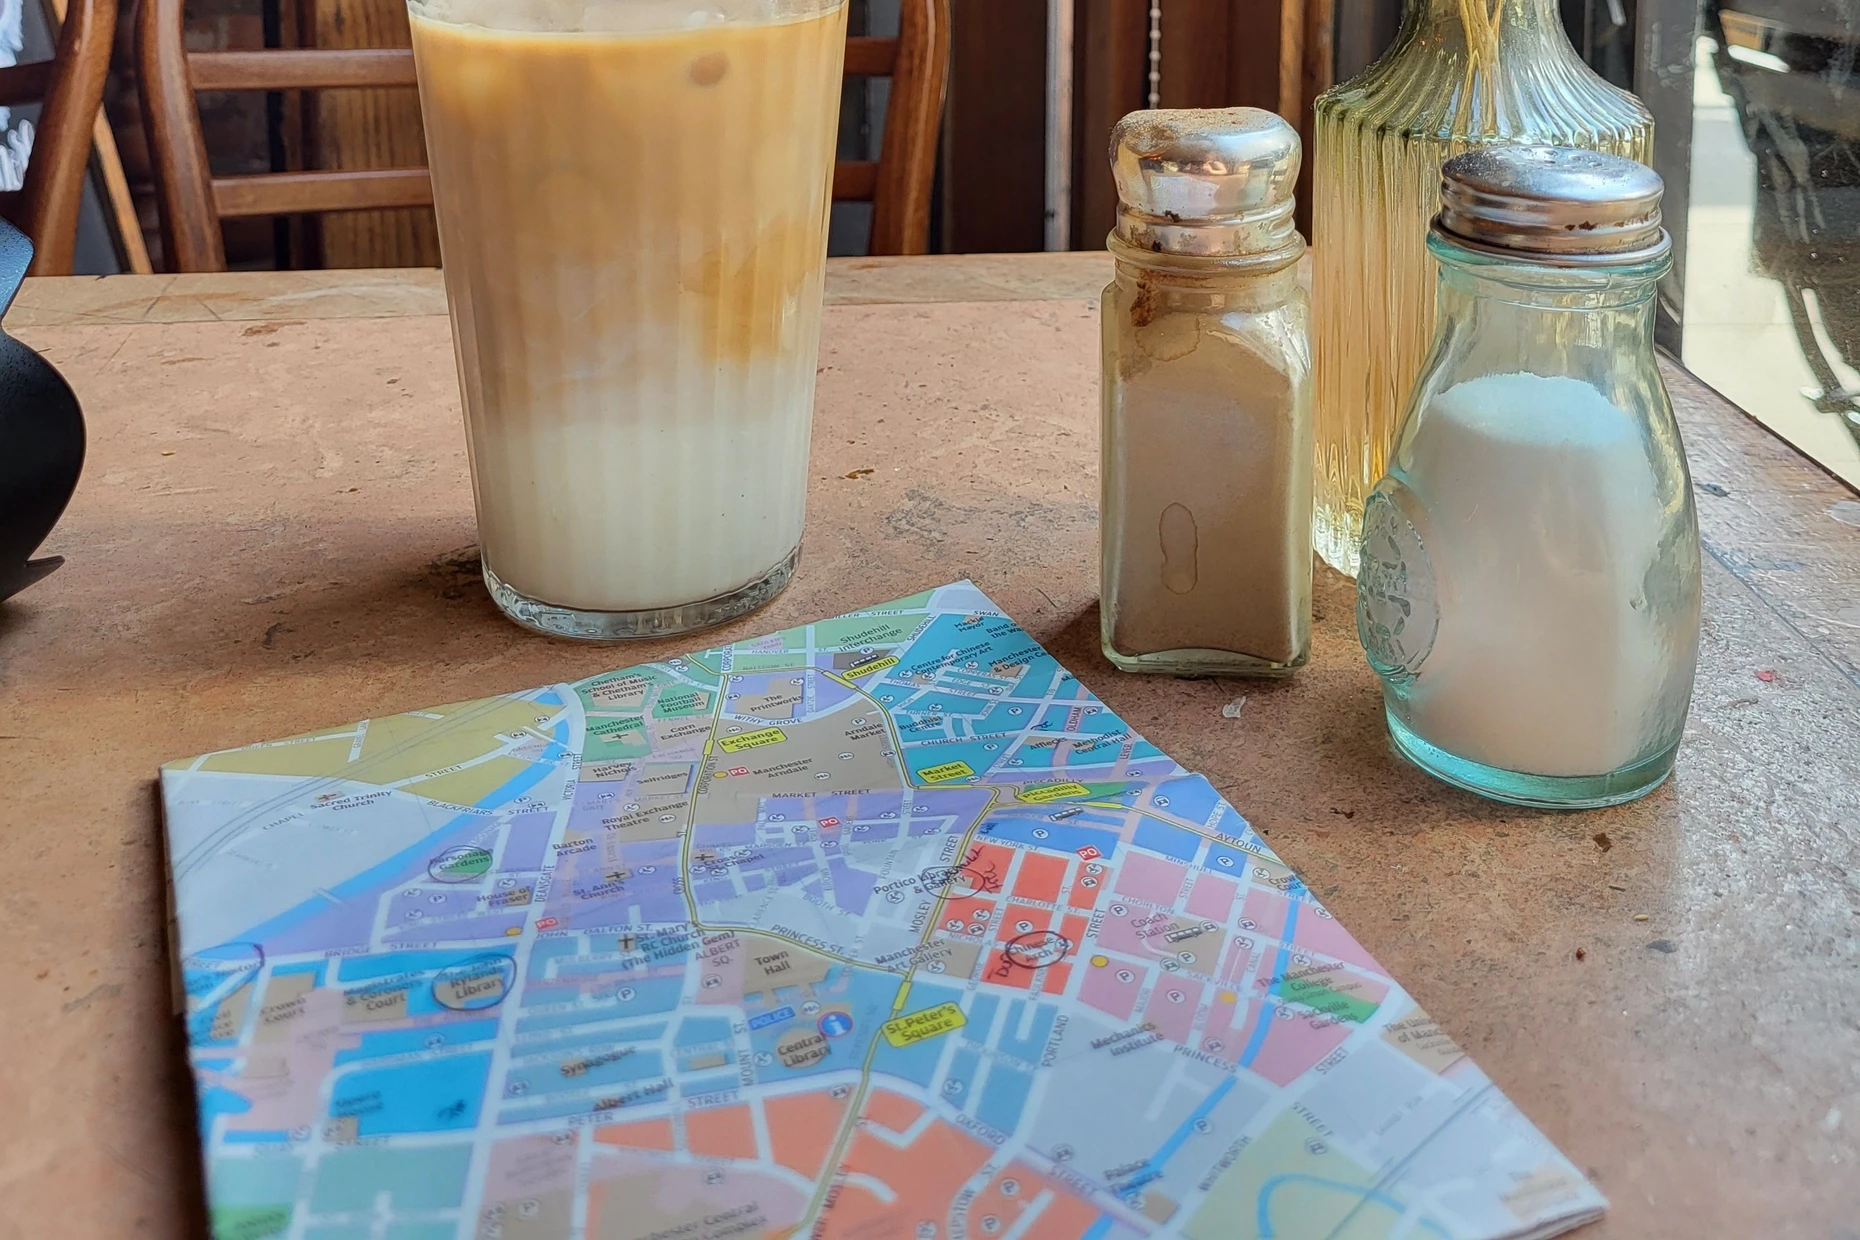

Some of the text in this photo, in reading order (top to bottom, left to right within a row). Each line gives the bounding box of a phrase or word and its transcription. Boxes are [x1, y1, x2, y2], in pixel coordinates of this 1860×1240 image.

[840, 624, 889, 643] Shudehill
[907, 615, 936, 642] SHUDEHILL
[839, 627, 903, 652] Interchange
[911, 641, 991, 671] Centre Chinese
[915, 651, 978, 675] Contemporary
[988, 646, 1041, 667] Manchester
[1003, 654, 1035, 671] Design
[846, 658, 896, 679] Shudehill
[581, 675, 657, 694] School Music
[591, 673, 641, 687] Chetham's
[602, 682, 654, 696] Chetham's
[608, 689, 644, 701] Library
[657, 692, 699, 703] National
[661, 697, 702, 709] Football
[750, 695, 803, 712] Printworks
[764, 694, 782, 702] The
[663, 701, 705, 713] Museum
[585, 715, 644, 732] Manchester
[733, 714, 803, 726] WITHY GROVE
[899, 716, 942, 731] Buddhist
[909, 722, 941, 733] Centre
[1067, 707, 1081, 731] OLDHAM
[593, 721, 644, 736] Cathedral
[660, 725, 711, 740] Exchange
[844, 723, 883, 736] Arndale
[849, 728, 887, 742] Market
[721, 728, 781, 747] Exchange
[735, 736, 778, 750] Square
[921, 732, 1007, 746] CHURCH STREET
[1072, 730, 1122, 749] Methodist
[425, 765, 463, 779] STREET
[592, 762, 633, 774] Harvey
[595, 765, 638, 779] Nichols
[730, 767, 748, 776] PO
[752, 757, 814, 776] Manchester
[767, 765, 809, 779] Arndale
[922, 763, 964, 778] Market
[637, 771, 688, 784] Selfridges
[930, 769, 967, 782] Street
[310, 790, 392, 810] Sacred Trinity
[772, 791, 817, 799] MARKET
[1023, 785, 1078, 799] Piccadilly
[1033, 789, 1082, 802] Gardens
[332, 799, 374, 812] Church
[427, 800, 549, 816] BLACKFRIARS STREET
[602, 813, 633, 825] Royal
[636, 801, 689, 818] Exchange
[262, 812, 304, 831] CHAPEL
[604, 817, 650, 831] Theatre
[820, 817, 839, 827] PO
[552, 837, 594, 850] Barton
[556, 844, 597, 857] Arcade
[940, 835, 959, 862] STREET
[976, 834, 1027, 850] NEW YORK
[1216, 833, 1261, 853] AYTOUN
[1079, 848, 1096, 858] PO
[439, 856, 490, 871] Gardens
[535, 864, 555, 903] DEANSGATE
[873, 878, 916, 894] Portico
[477, 890, 515, 902] House
[488, 894, 529, 907] Fraser
[581, 885, 624, 900] Church
[909, 900, 932, 933] MOSLEY
[1087, 909, 1105, 938] STREET
[1131, 913, 1168, 929] Coach
[583, 924, 633, 935] DALTON
[657, 921, 698, 938] Mary's
[771, 924, 828, 950] PRINCESS
[1136, 922, 1179, 940] Station
[622, 954, 651, 970] (The
[653, 940, 700, 960] Hidden
[702, 929, 736, 946] Gem)
[641, 929, 706, 953] RC Church
[1010, 937, 1054, 956] Chinese
[695, 939, 741, 961] ALBERT
[754, 950, 790, 967] Town
[874, 938, 945, 964] Manchester
[909, 947, 952, 966] Gallery
[1025, 949, 1052, 962] Arch
[764, 961, 791, 976] Hall
[1256, 961, 1345, 988] The Manchester
[450, 966, 504, 989] Rylands
[1290, 976, 1334, 992] College
[456, 978, 504, 999] Library
[366, 992, 408, 1011] Court
[751, 1009, 794, 1028] POLICE
[1299, 1001, 1349, 1020] Sackville
[902, 1018, 955, 1041] Square
[1309, 1013, 1358, 1030] Gardens
[1043, 1016, 1069, 1067] PORTLAND
[1090, 1022, 1156, 1050] Mechanics
[1110, 1032, 1165, 1057] Institute
[777, 1034, 827, 1056] Central
[783, 1045, 832, 1068] Library
[1174, 1045, 1237, 1073] PRINCESS
[1315, 1047, 1348, 1075] STREET
[739, 1049, 754, 1087] MOUNT
[568, 1091, 739, 1126] PETER STREET
[1292, 1102, 1334, 1137] STREET
[956, 1113, 1006, 1146] OXFORD
[1050, 1164, 1099, 1195] STREET
